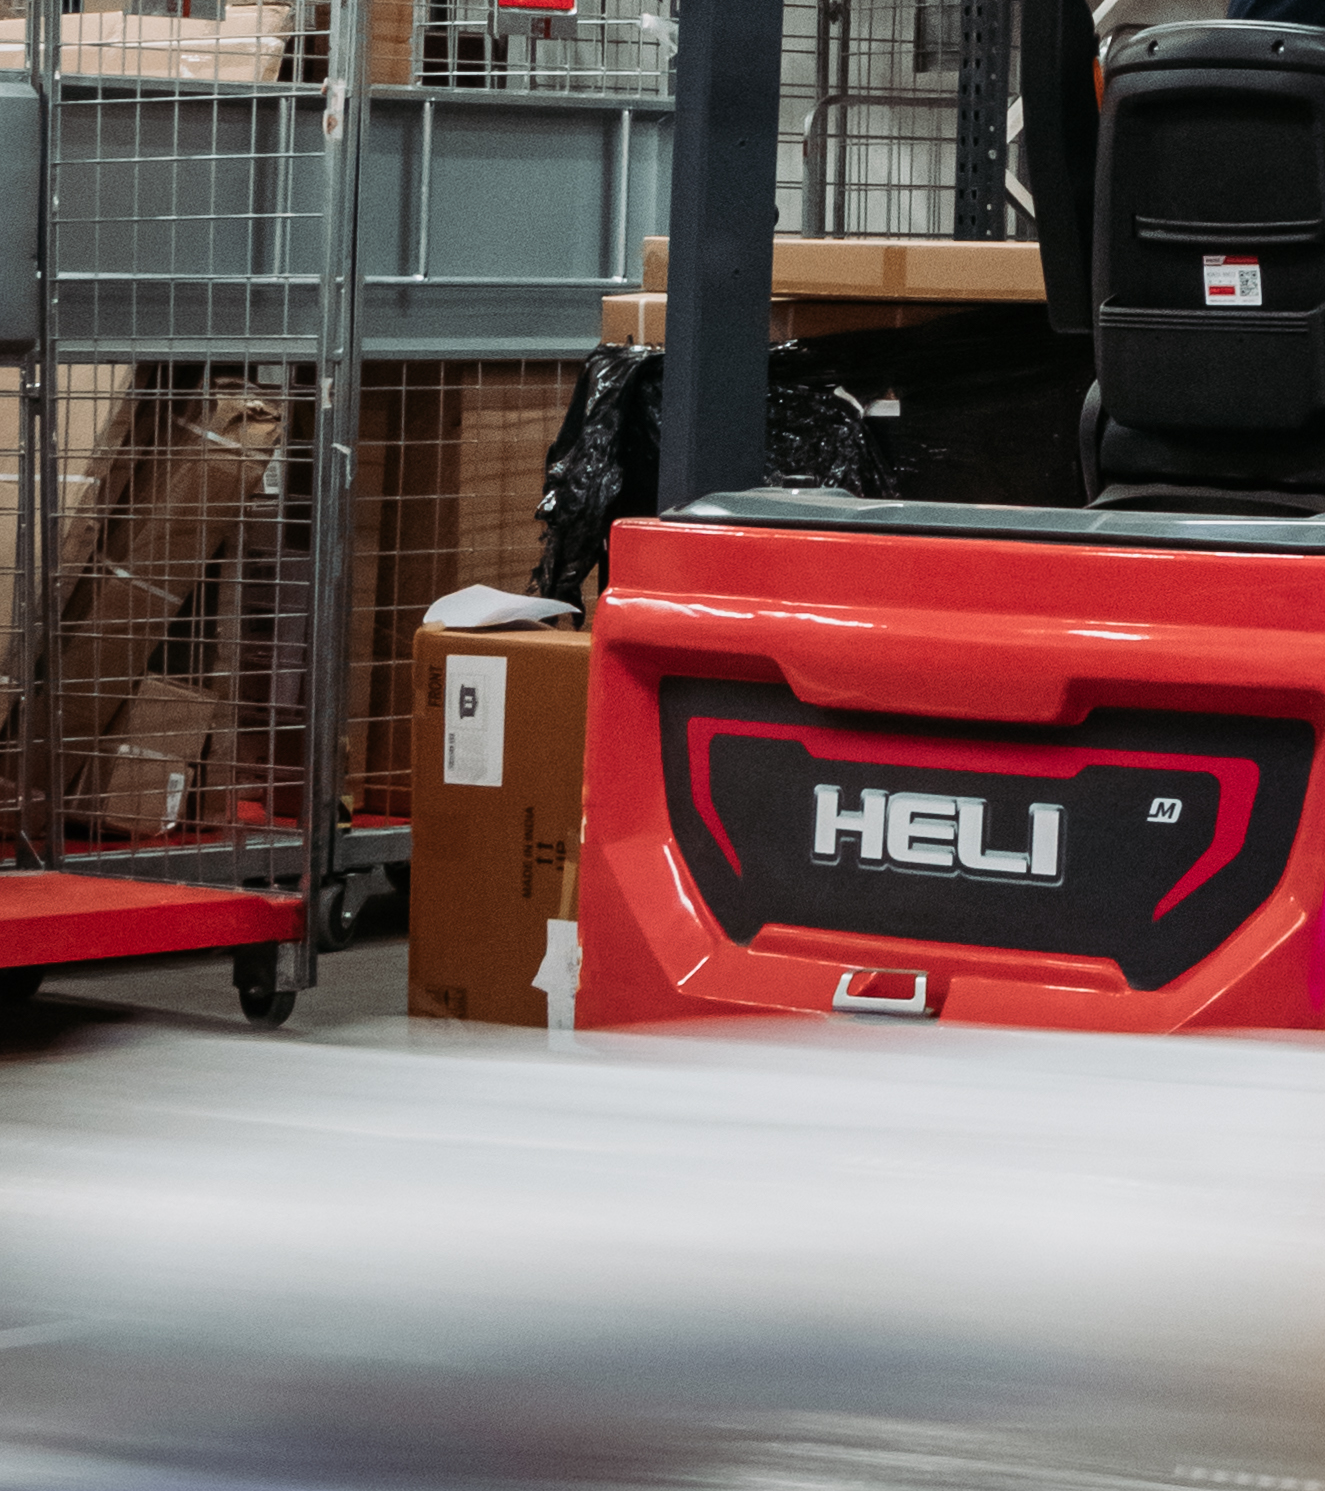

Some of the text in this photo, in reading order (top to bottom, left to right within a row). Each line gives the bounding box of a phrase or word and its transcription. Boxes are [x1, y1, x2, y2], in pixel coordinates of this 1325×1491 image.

[428, 665, 443, 708] FRONT
[521, 806, 536, 900] MADE IN INDIA
[812, 784, 1064, 881] HELI
